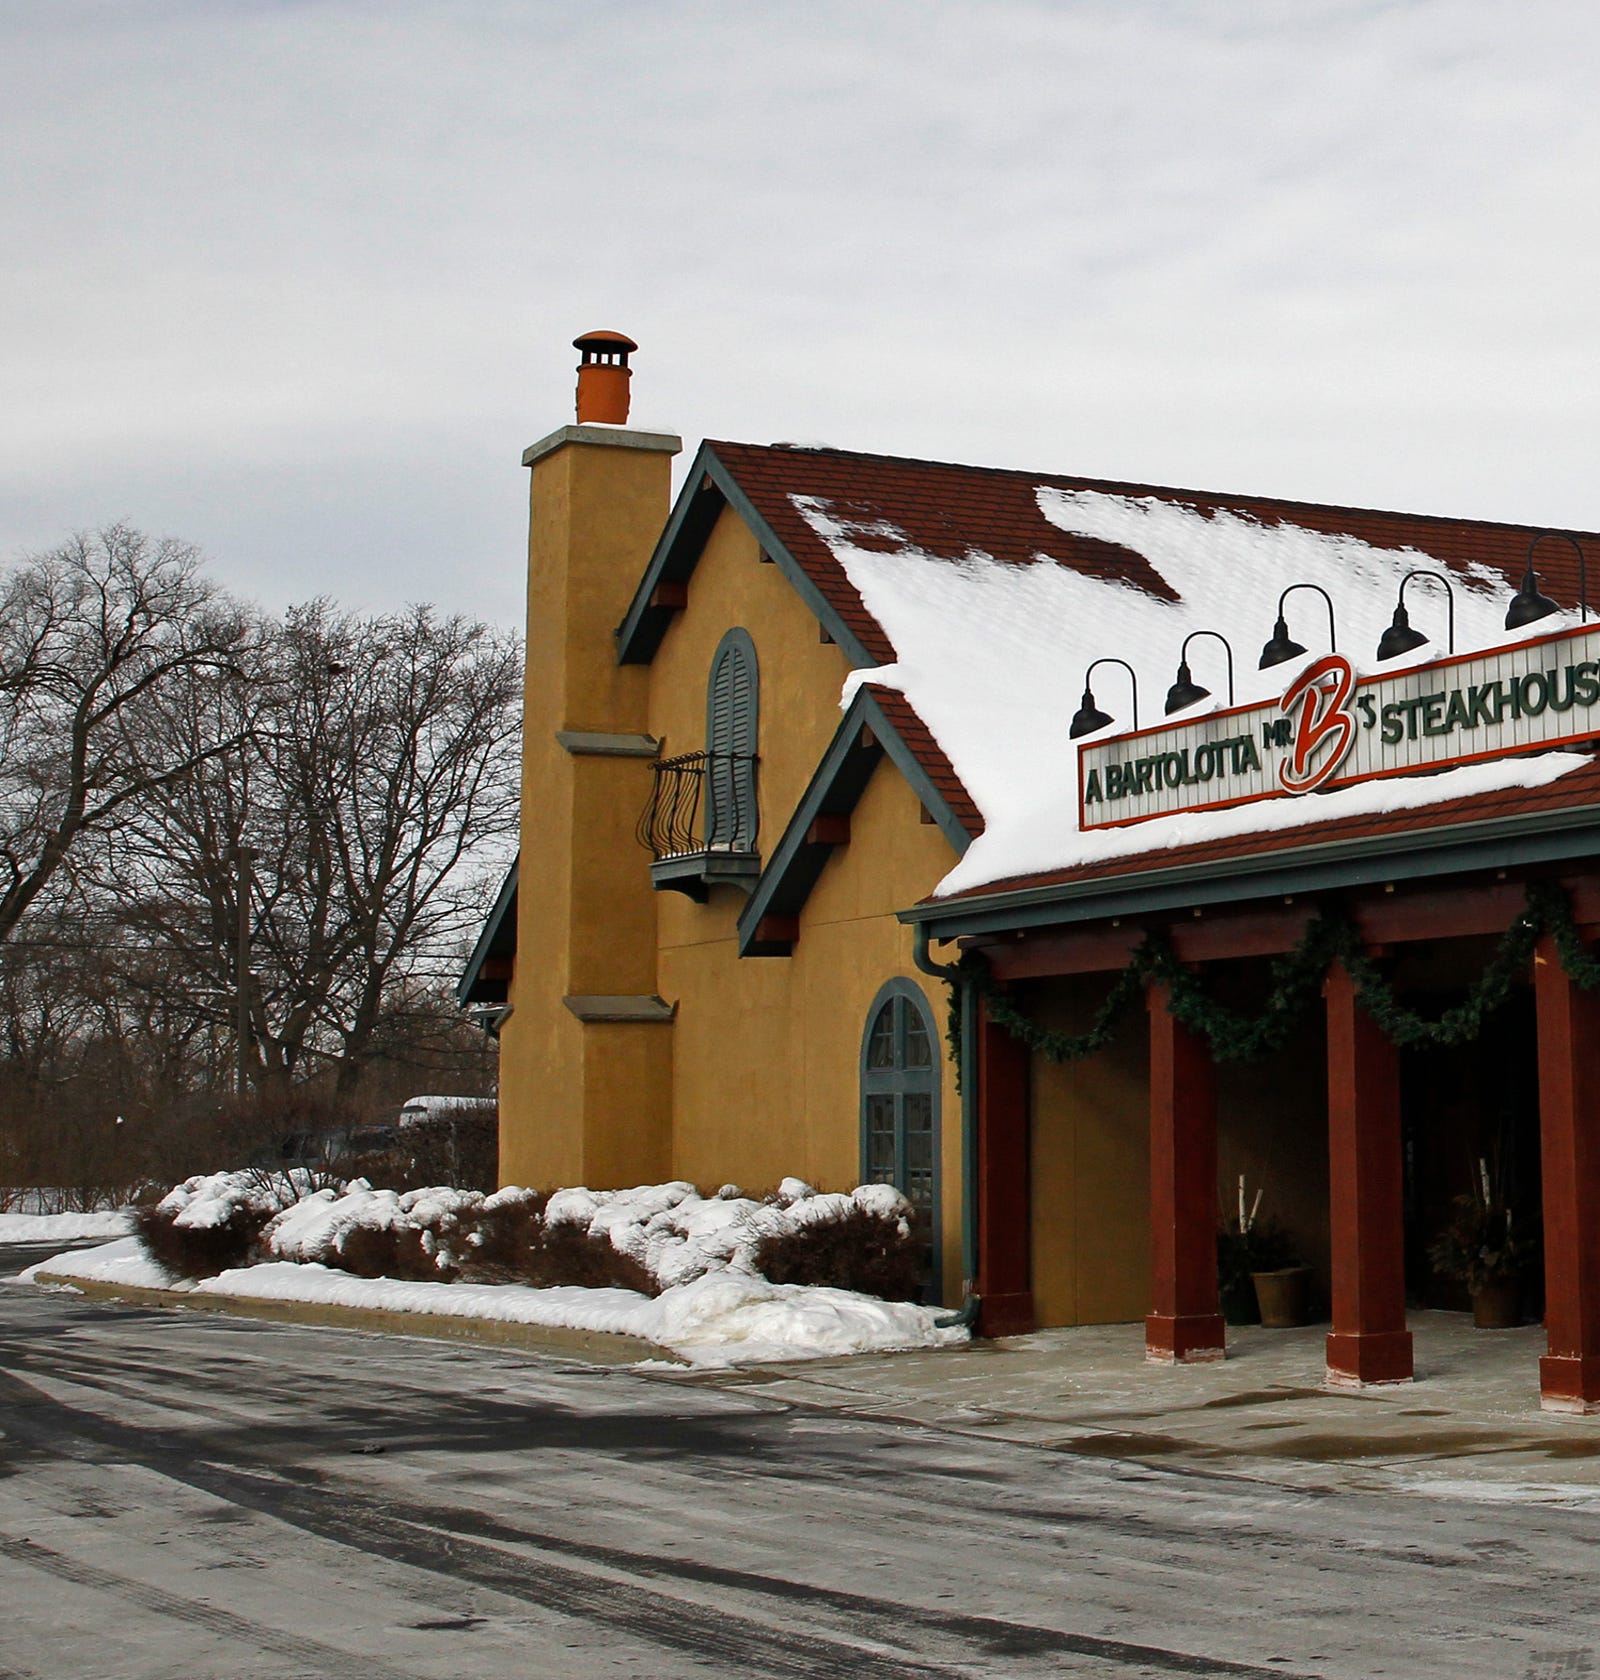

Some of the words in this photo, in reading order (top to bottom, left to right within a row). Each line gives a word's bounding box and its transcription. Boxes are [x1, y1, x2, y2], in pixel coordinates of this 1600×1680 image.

[1085, 768, 1103, 804] A
[1105, 734, 1262, 800] BARTOLOTTA
[1262, 718, 1295, 750] MR.
